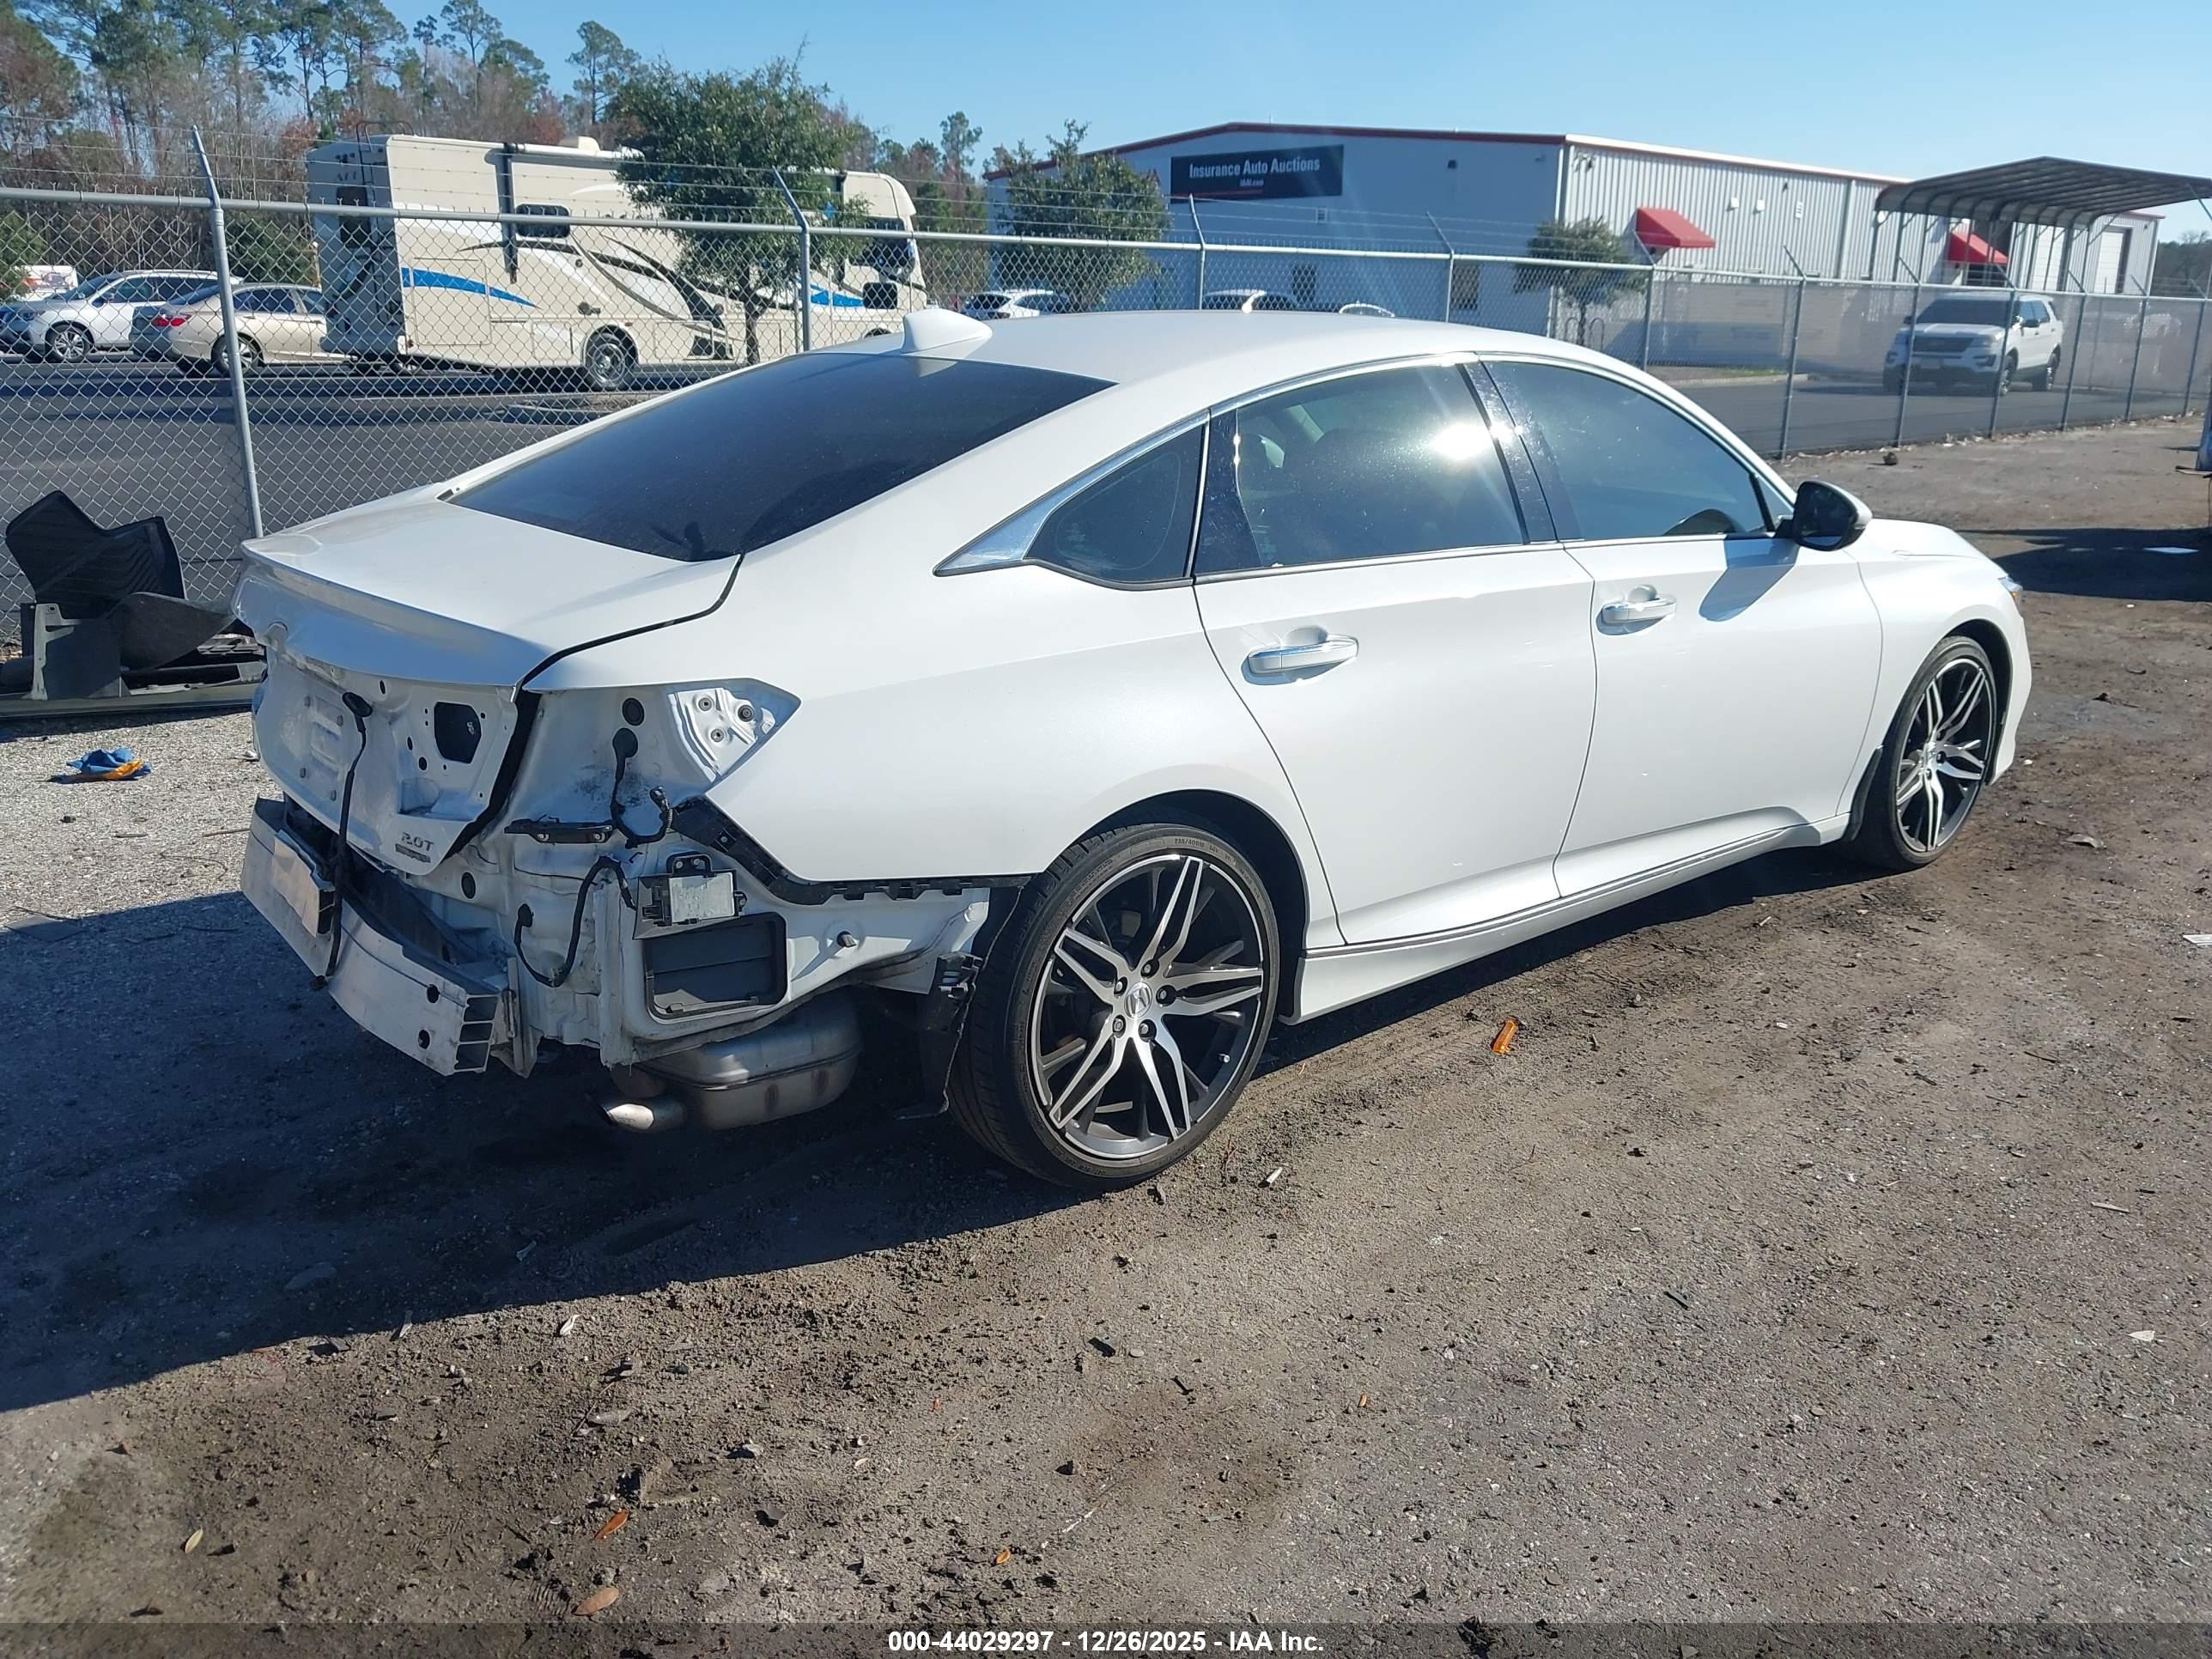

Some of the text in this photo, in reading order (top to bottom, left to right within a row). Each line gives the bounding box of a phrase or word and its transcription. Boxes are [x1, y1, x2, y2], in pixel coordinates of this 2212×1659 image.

[1189, 156, 1321, 179] Insurance Auto Auctions
